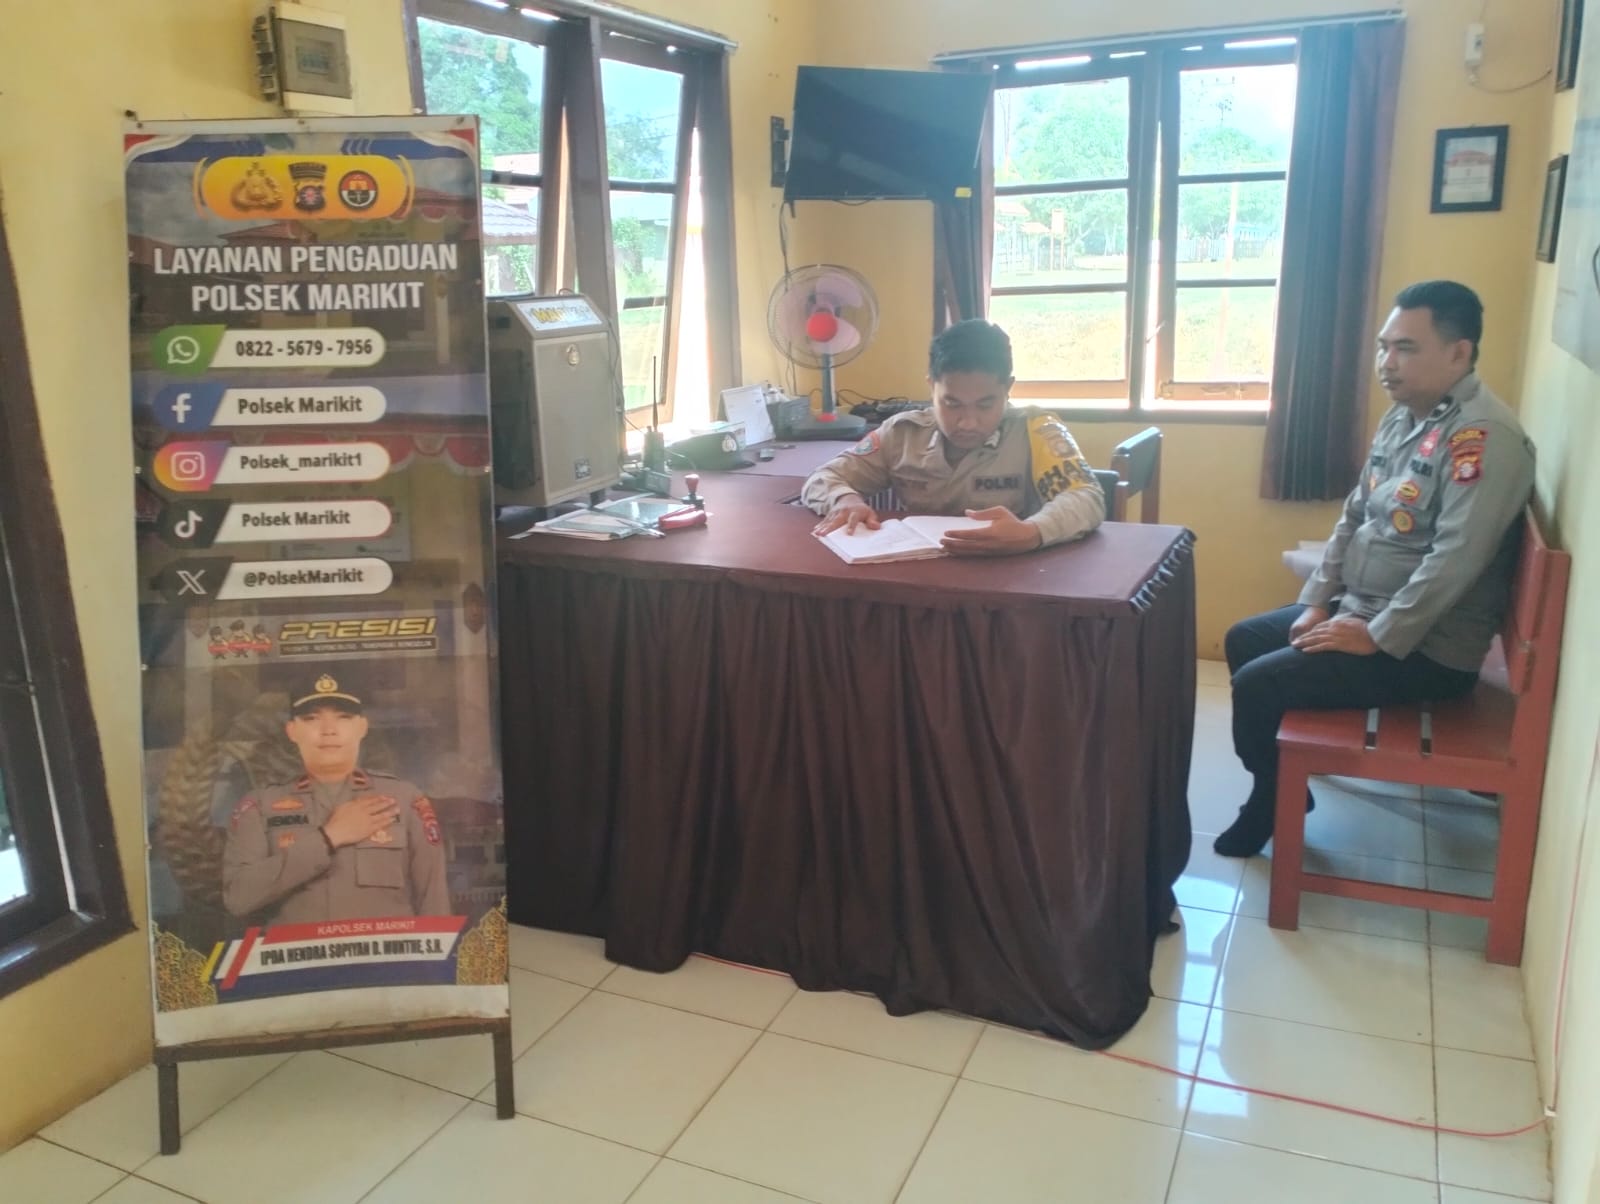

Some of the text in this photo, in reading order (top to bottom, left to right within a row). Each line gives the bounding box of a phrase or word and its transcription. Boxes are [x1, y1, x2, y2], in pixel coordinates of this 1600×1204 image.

[154, 244, 457, 274] LAYANAN PENGADUAN
[192, 281, 424, 312] POLSEK MARIKIT
[235, 340, 274, 357] 0822
[287, 339, 323, 356] 5679
[336, 338, 373, 355] 7956
[238, 396, 363, 414] Polsek Marikit
[240, 452, 362, 471] Polsek_marikit1
[975, 476, 1020, 491] POLRI
[242, 510, 351, 528] Polsek Marikit
[243, 568, 364, 588] @PolsekMarikit
[280, 616, 437, 641] PRESISI
[317, 920, 417, 936] KAPOLSEK MARIKIT
[260, 948, 286, 967] IPDA
[287, 944, 328, 963] HENDRA
